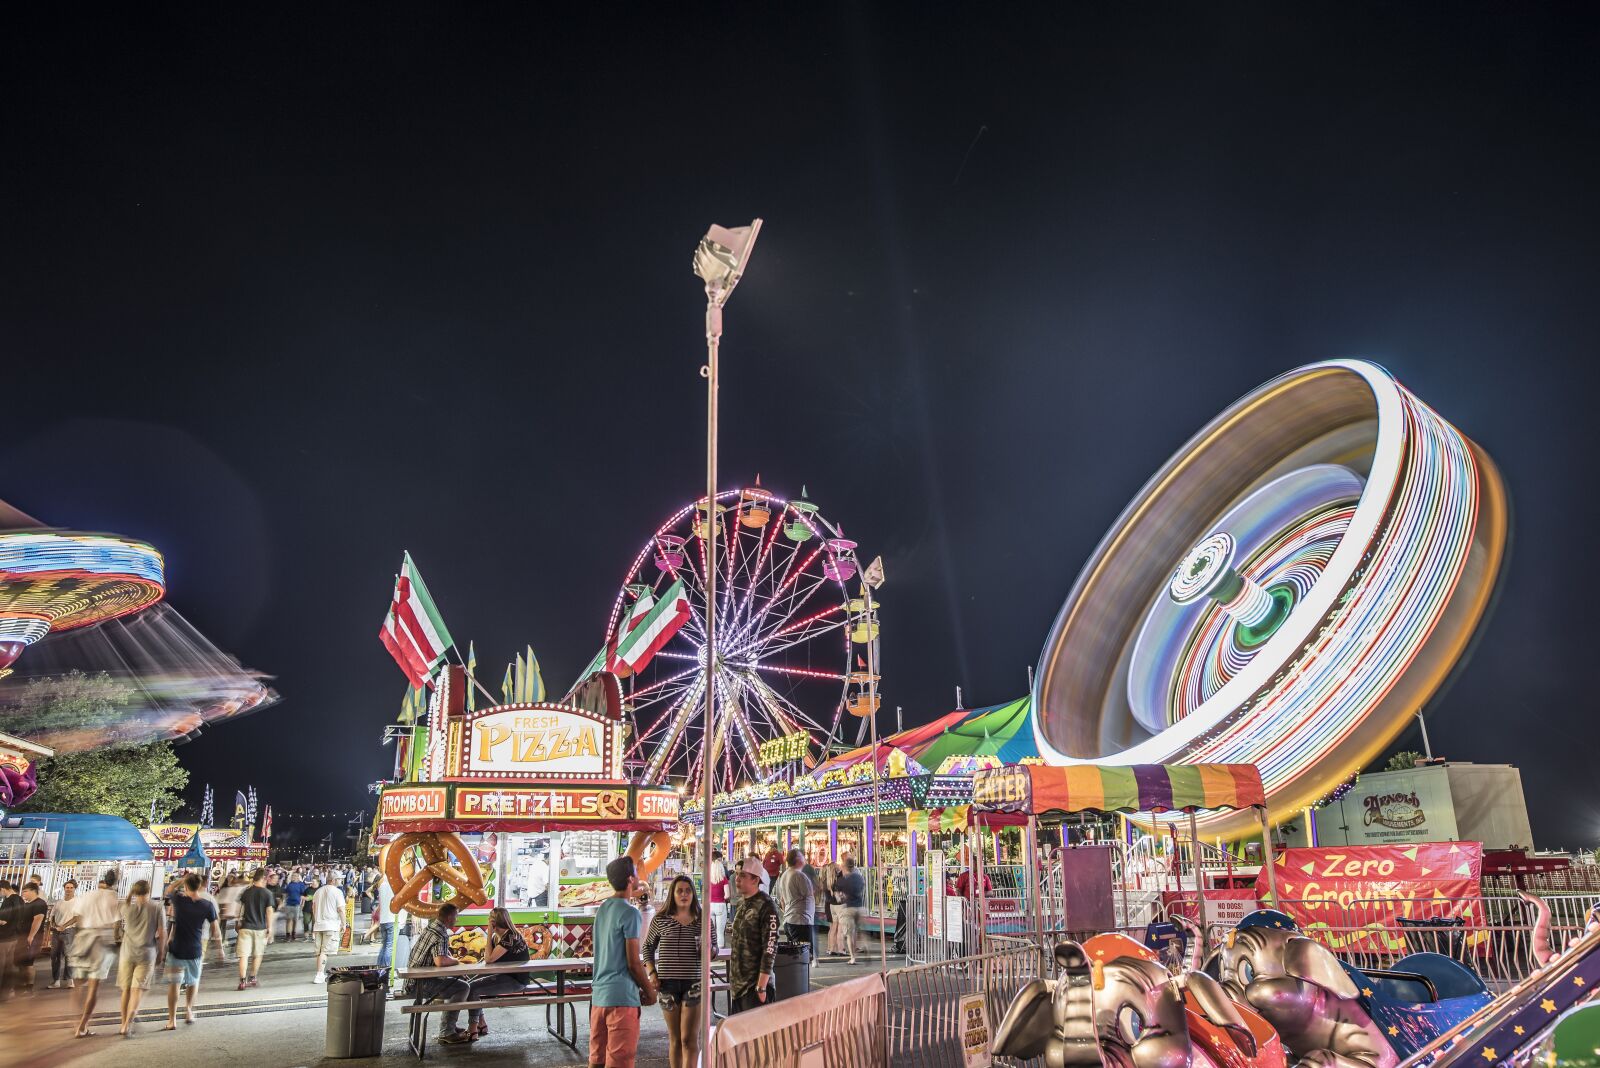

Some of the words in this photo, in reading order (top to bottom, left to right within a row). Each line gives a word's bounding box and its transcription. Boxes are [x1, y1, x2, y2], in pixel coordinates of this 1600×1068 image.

[514, 716, 559, 729] FRESH
[475, 721, 600, 762] PIZZA
[975, 773, 1026, 803] ENTER
[383, 794, 440, 814] STROMBOLI
[465, 794, 598, 814] PRETZELS
[1363, 791, 1420, 818] ARNOLD
[160, 826, 191, 836] SAUSAGE
[174, 849, 238, 857] BGERS
[1322, 854, 1395, 878] Zero
[1217, 902, 1226, 910] NO
[1226, 902, 1244, 910] DOGS!
[1301, 883, 1416, 920] Gravity
[1217, 911, 1226, 919] NO
[1226, 911, 1245, 919] BIKES!
